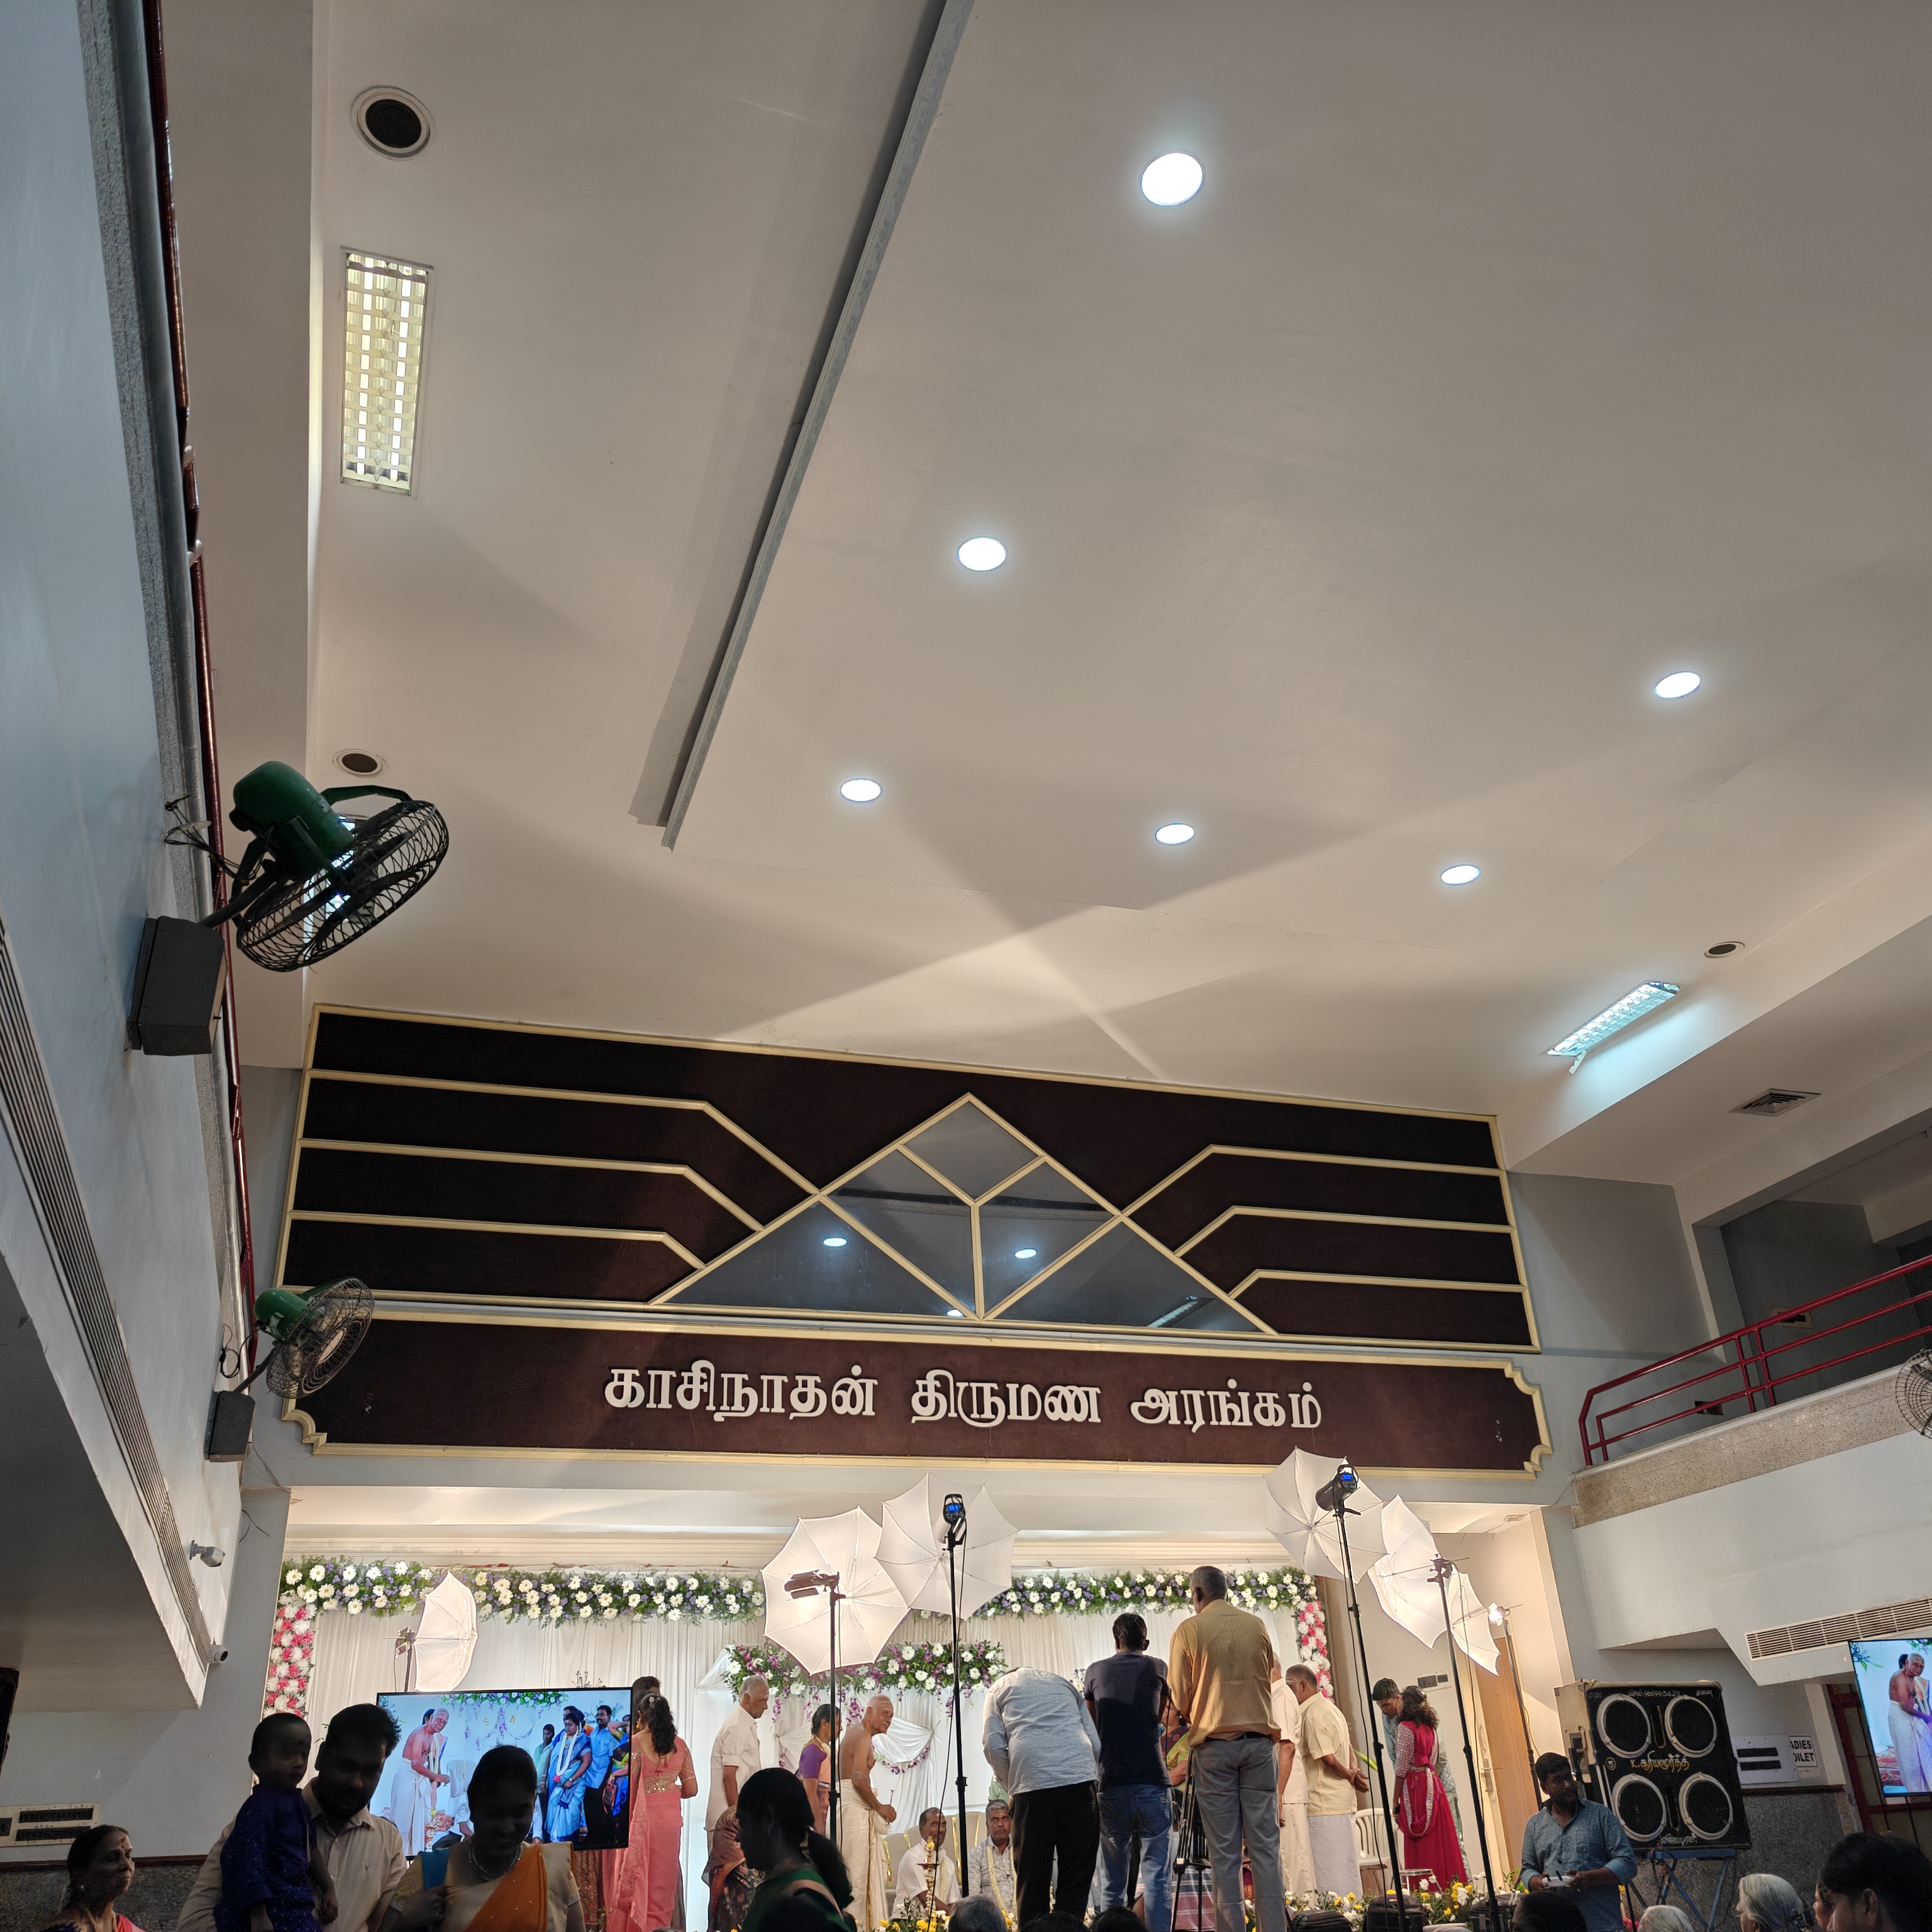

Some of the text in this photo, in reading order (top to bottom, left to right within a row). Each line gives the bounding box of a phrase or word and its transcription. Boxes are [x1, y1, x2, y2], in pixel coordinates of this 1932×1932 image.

[604, 1360, 1321, 1433] காசிநாதன் திருமண அரங்கம்
